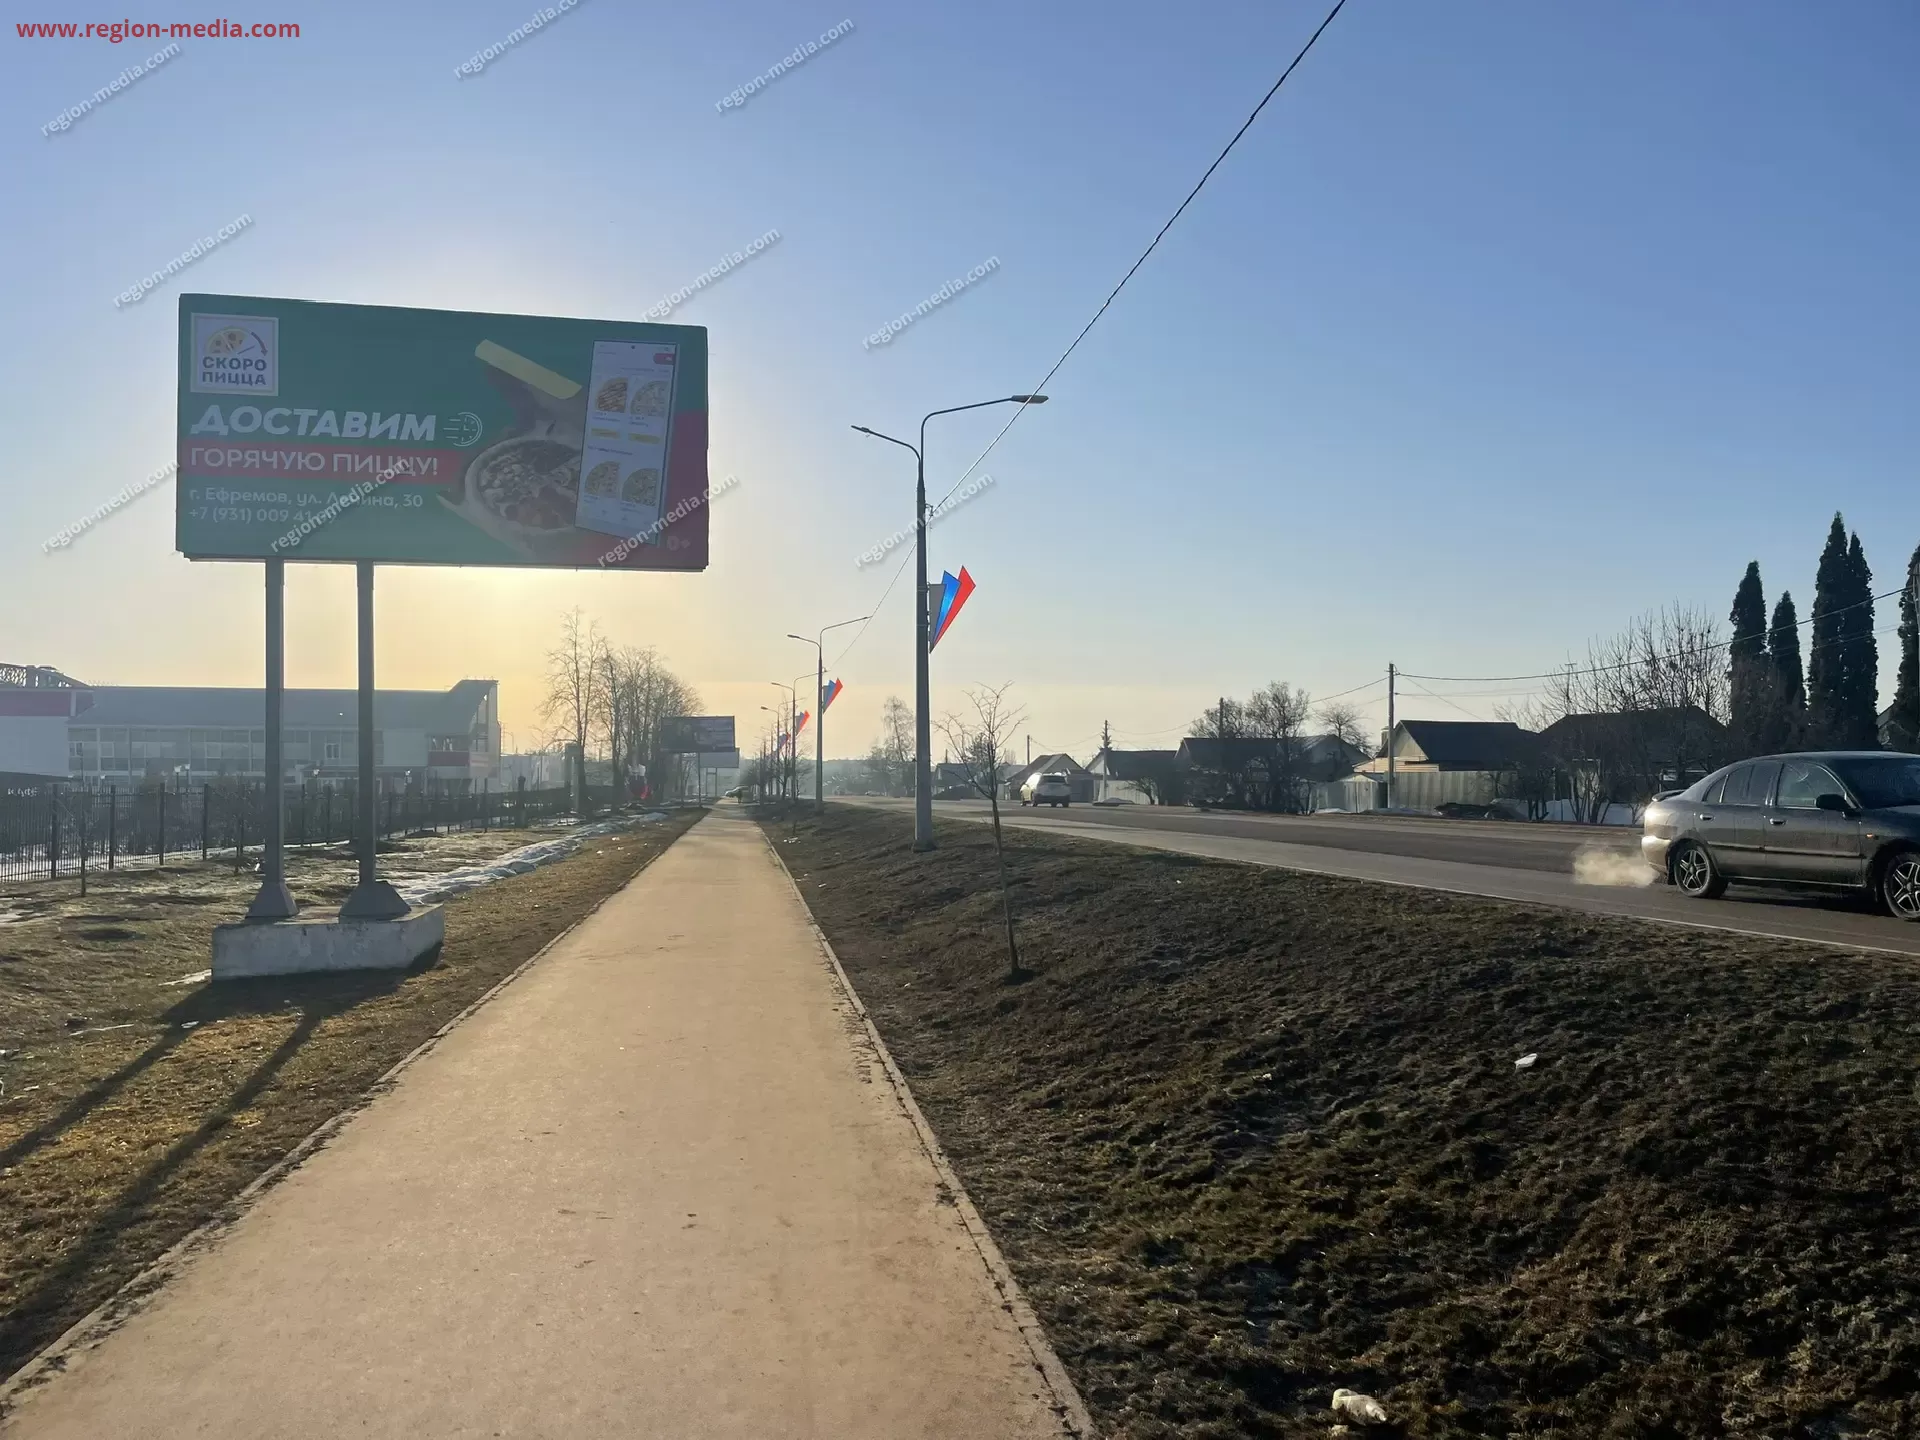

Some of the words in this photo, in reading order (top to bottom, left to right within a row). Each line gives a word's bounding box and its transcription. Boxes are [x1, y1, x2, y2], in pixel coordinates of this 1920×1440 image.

[202, 356, 267, 371] СКОРО
[202, 371, 267, 386] ПИЦЦА
[190, 404, 437, 441] ДОСТАВИМ
[191, 447, 326, 472] ГОРЯЧУЮ
[189, 489, 200, 500] г.
[205, 487, 292, 505] Ефремов,
[296, 492, 322, 507] ул.
[326, 491, 398, 508] Лина,
[403, 493, 423, 508] 30
[188, 507, 207, 521] +7
[213, 507, 252, 523] (931)
[256, 508, 289, 522] 009
